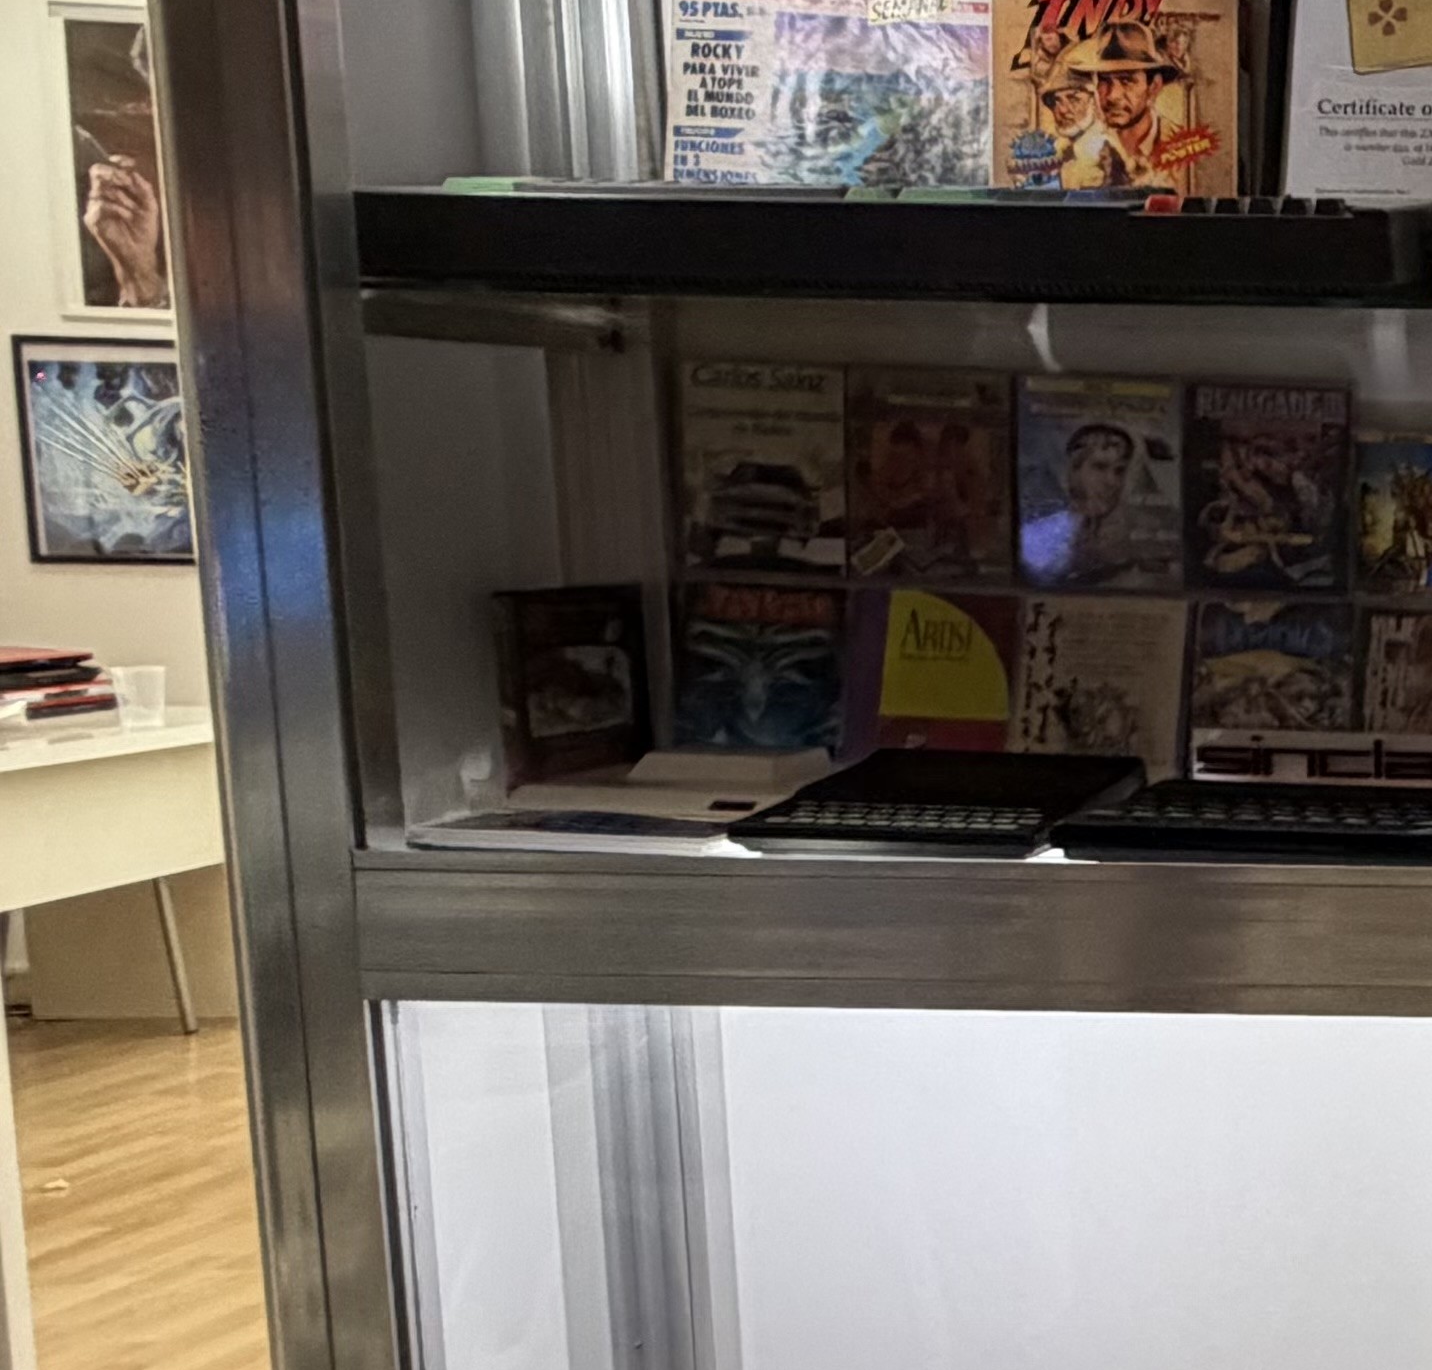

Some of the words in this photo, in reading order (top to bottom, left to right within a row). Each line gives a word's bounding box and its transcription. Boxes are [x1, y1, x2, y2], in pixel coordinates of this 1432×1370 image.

[678, 1, 699, 17] 95
[700, 3, 744, 20] PTAS.
[690, 42, 745, 60] ROCKY
[682, 62, 717, 77] PARA
[686, 91, 701, 104] EL
[703, 91, 754, 106] MUNDO
[684, 105, 707, 120] DEL
[710, 106, 756, 122] BOXEO
[1316, 98, 1416, 116] Certificate
[673, 140, 745, 156] FUNCIONES
[673, 155, 691, 167] EN
